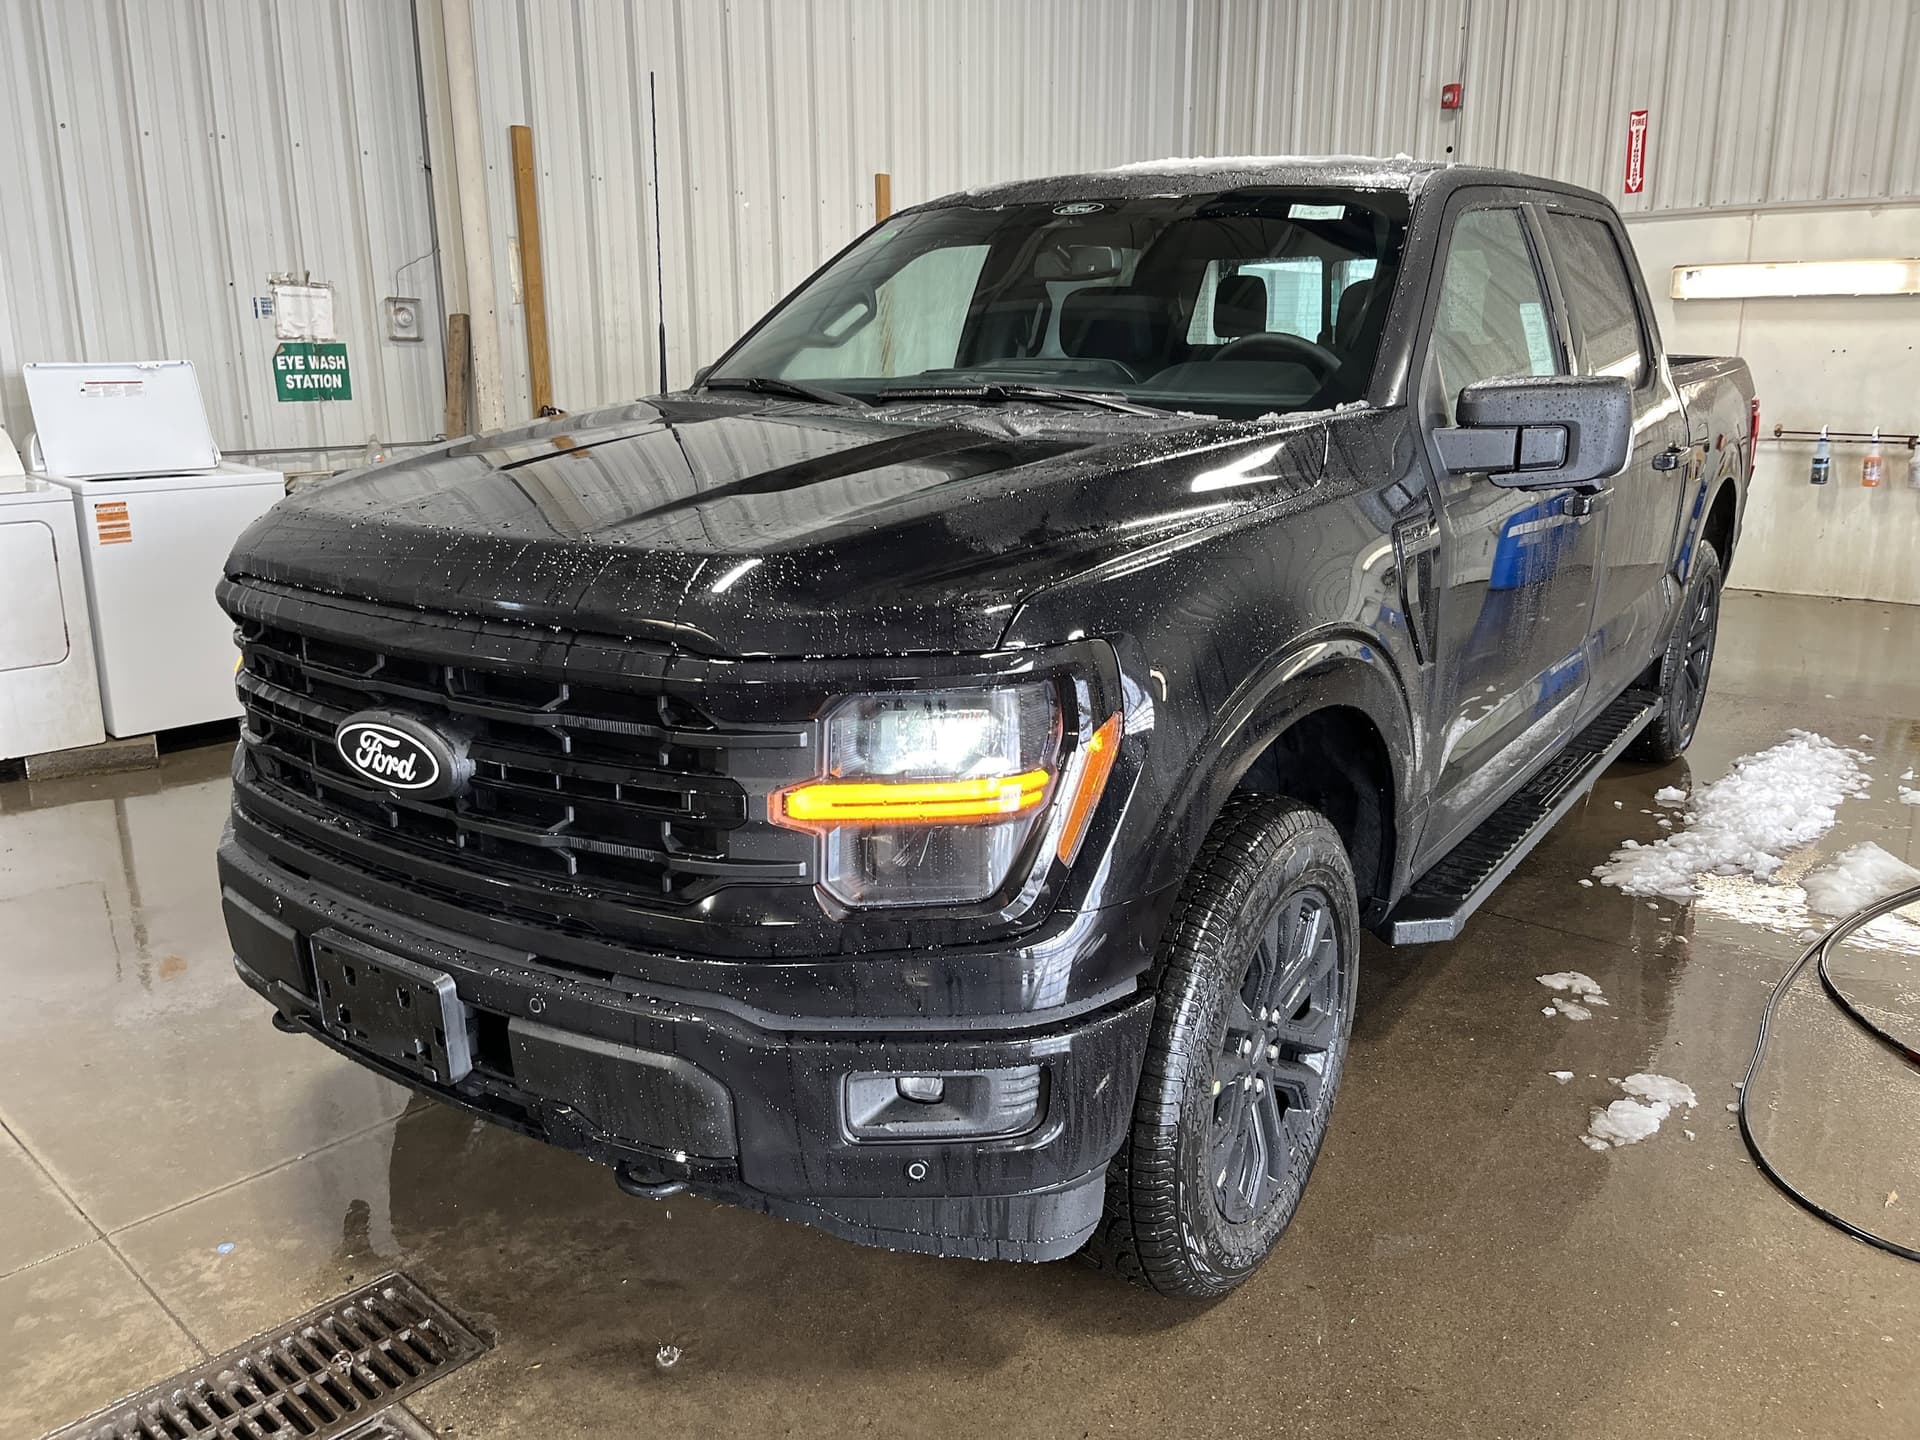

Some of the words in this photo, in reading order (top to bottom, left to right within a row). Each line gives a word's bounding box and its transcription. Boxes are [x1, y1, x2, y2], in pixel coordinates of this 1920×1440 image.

[1632, 118, 1645, 127] FIRE
[1631, 129, 1640, 187] EXTINGUISHER
[276, 355, 305, 370] EYE
[307, 354, 346, 370] WASH
[285, 373, 343, 389] STATION
[355, 730, 417, 781] Ford
